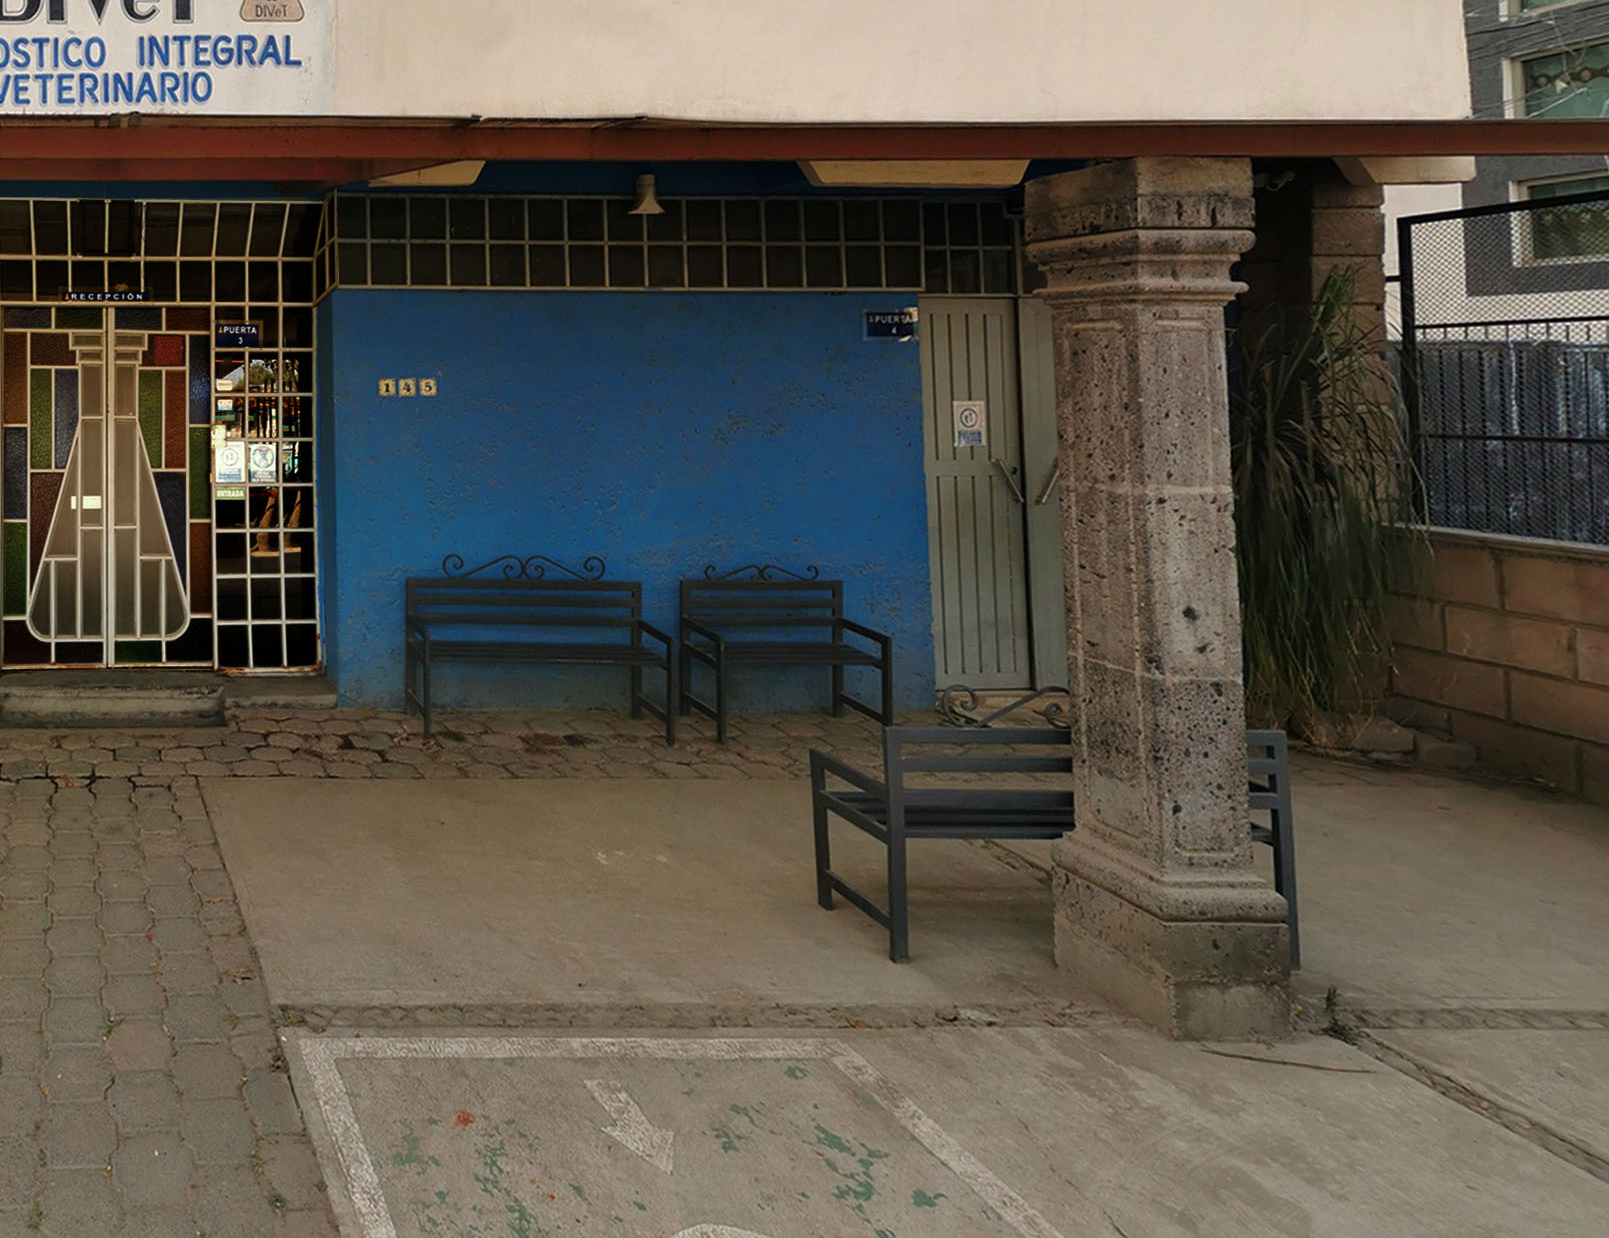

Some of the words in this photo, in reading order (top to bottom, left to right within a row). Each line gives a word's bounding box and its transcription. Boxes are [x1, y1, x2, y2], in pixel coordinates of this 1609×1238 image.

[255, 4, 288, 18] DIVeT
[138, 35, 303, 67] INTEGRAL
[71, 292, 143, 301] RECEPCIÓN
[223, 325, 257, 334] PUERTA
[237, 336, 244, 345] 3
